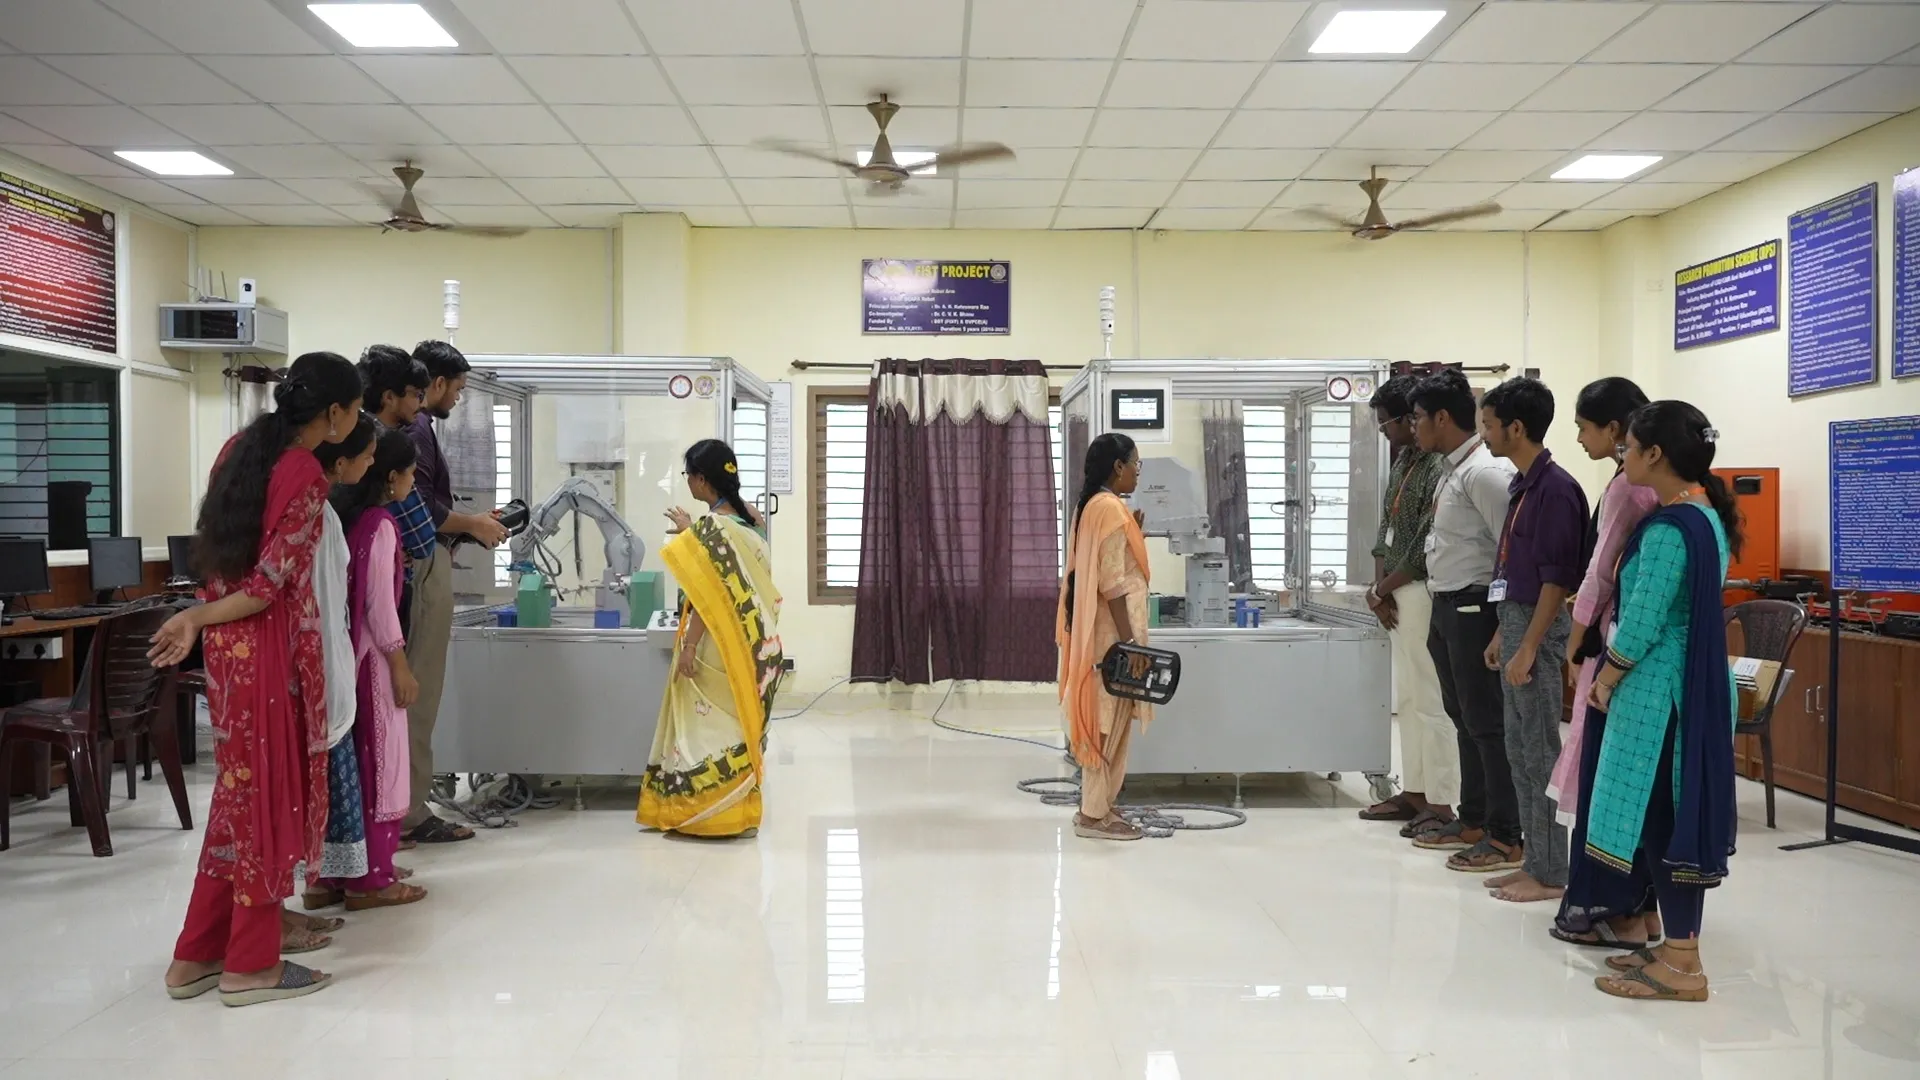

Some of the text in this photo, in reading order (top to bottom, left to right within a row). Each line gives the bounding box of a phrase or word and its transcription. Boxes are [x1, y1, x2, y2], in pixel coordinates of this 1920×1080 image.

[942, 265, 990, 278] PROJECT
[1677, 243, 1776, 286] RESEARCH PROMOTION SCHEME (RPS)
